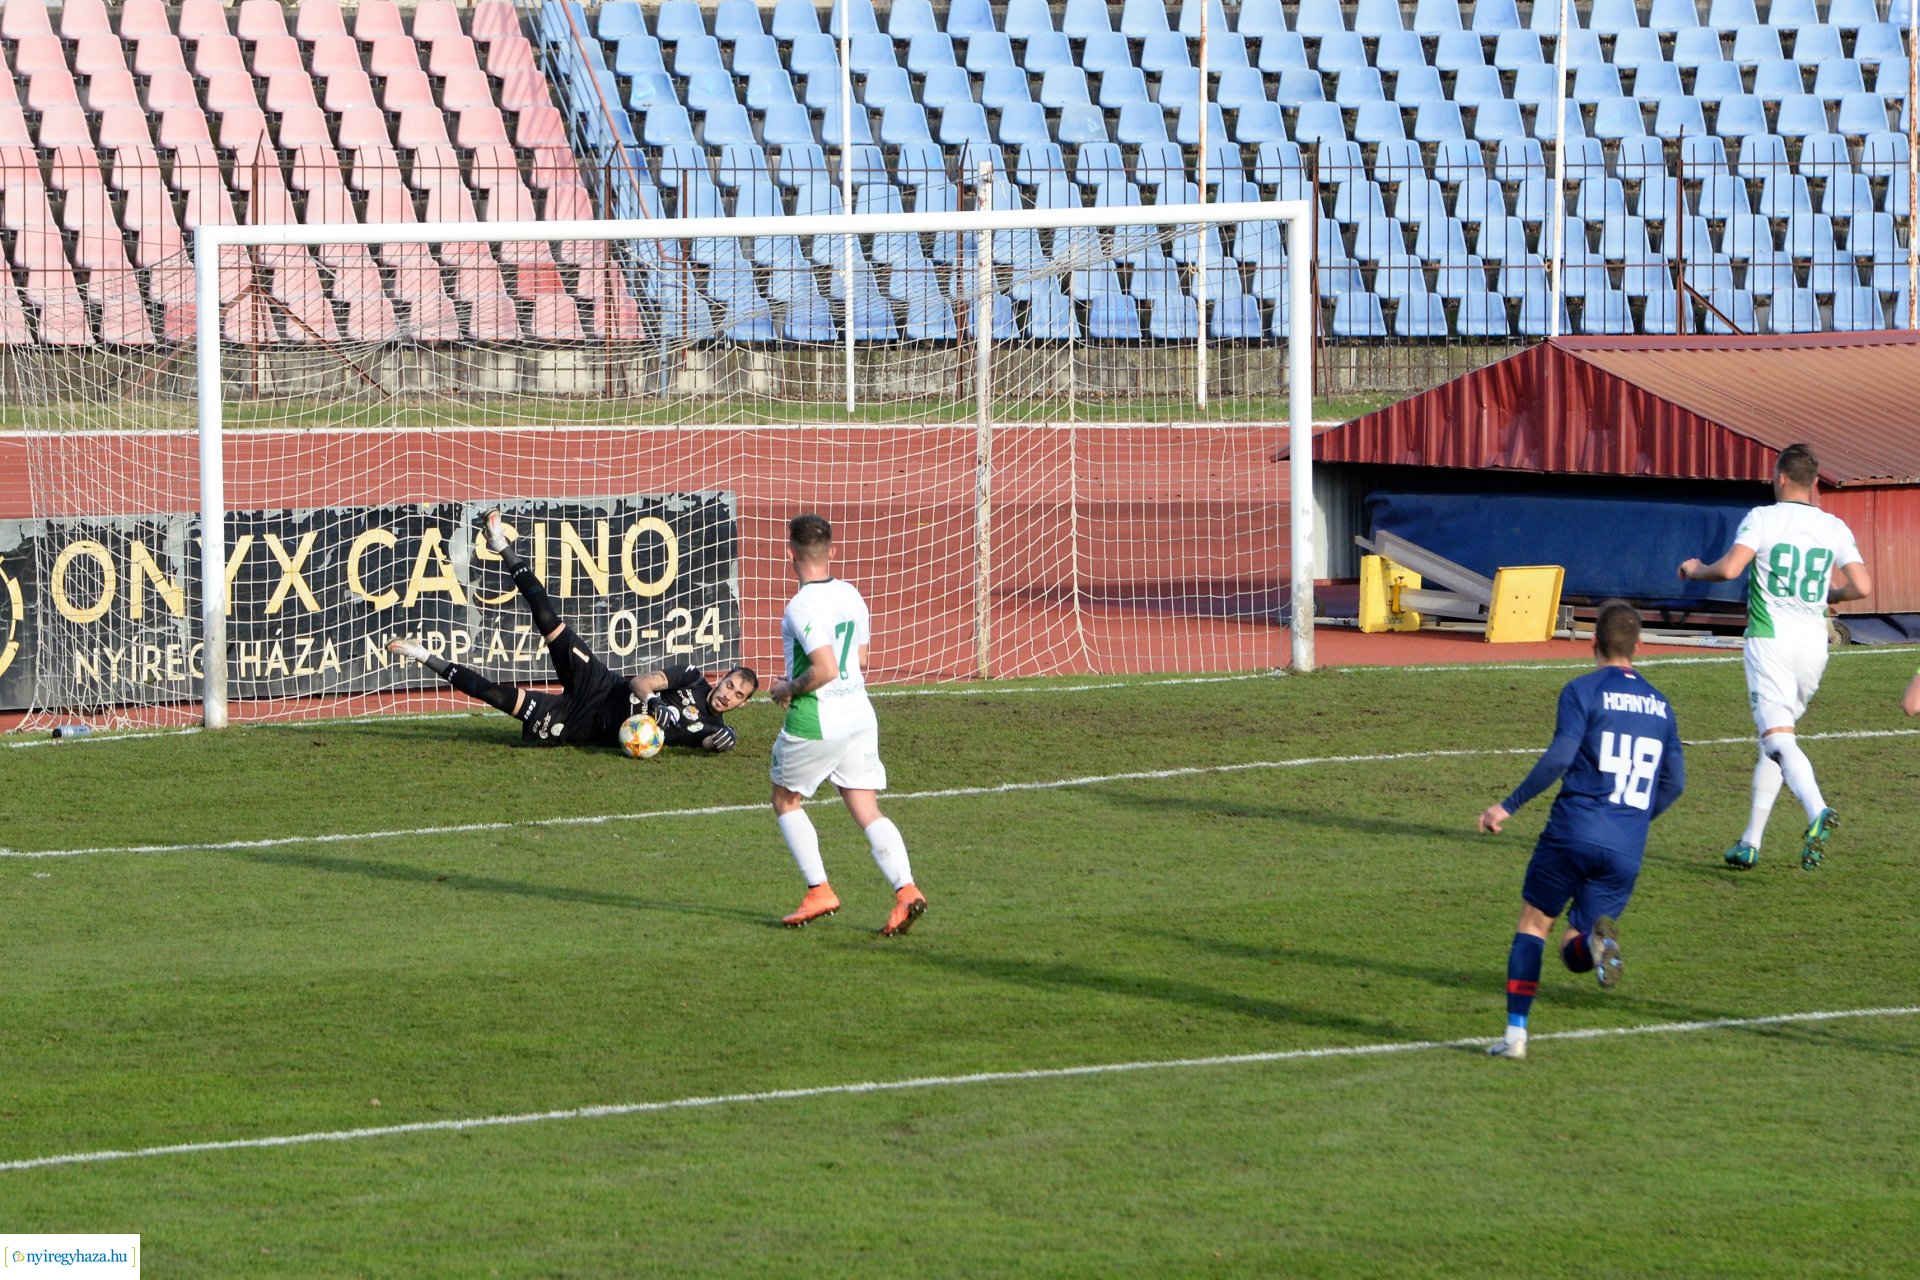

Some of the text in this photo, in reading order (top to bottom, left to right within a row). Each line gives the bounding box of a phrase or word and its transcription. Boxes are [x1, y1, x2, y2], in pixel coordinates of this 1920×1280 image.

[51, 517, 678, 623] ONYX CASINO
[1767, 543, 1834, 603] 88
[74, 628, 341, 685] NYÍREGHÁZA
[608, 607, 724, 657] 0-24
[834, 620, 855, 681] 7
[1603, 691, 1667, 719] HORNYÁK
[1598, 731, 1663, 811] 48
